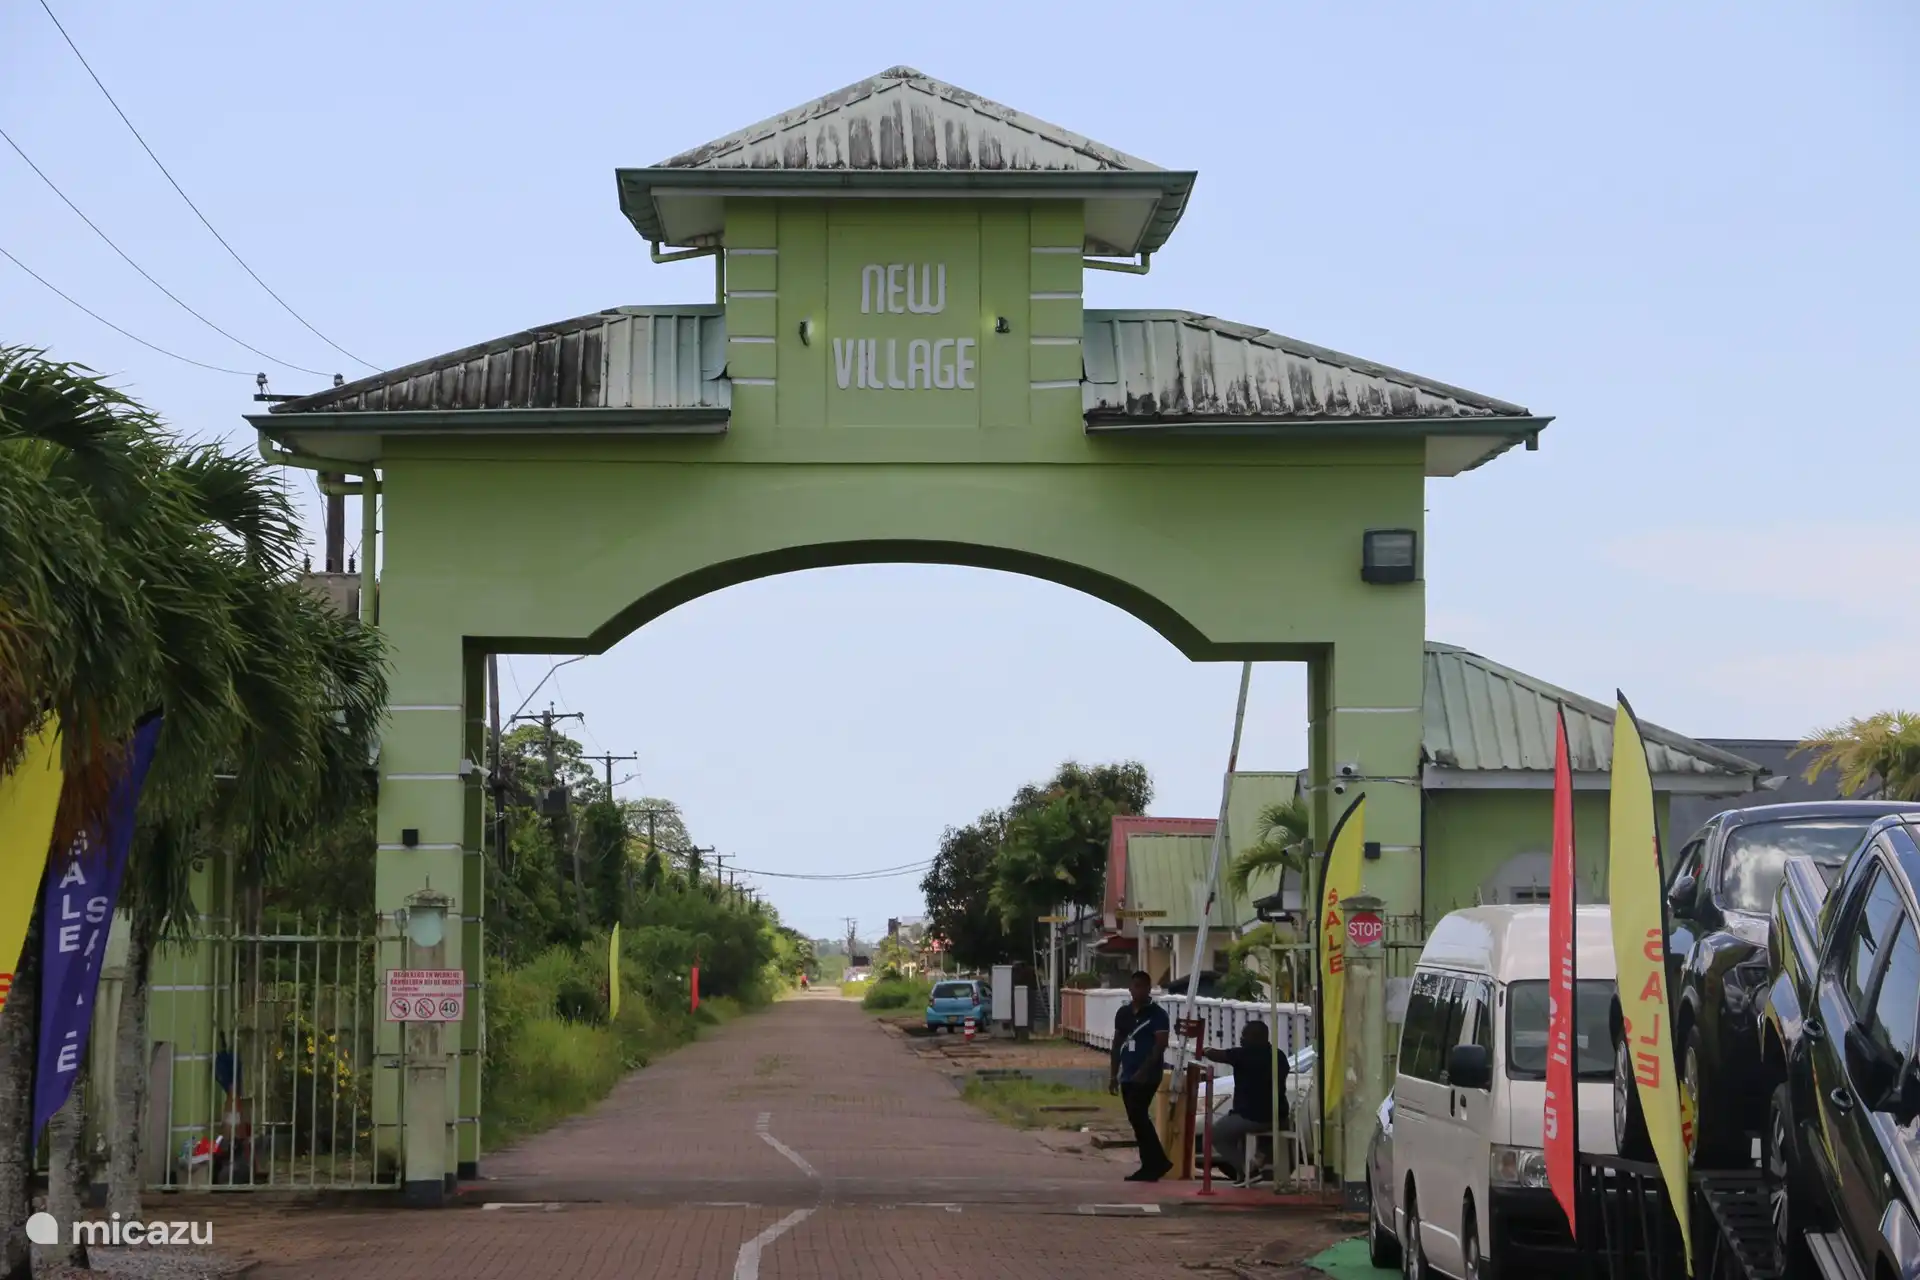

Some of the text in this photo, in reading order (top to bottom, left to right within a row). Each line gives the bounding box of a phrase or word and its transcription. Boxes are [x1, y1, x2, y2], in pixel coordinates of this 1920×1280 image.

[860, 262, 947, 314] NEW
[832, 337, 976, 390] VILLAGE
[1325, 888, 1344, 975] SALE
[1349, 922, 1383, 937] STOP
[443, 1002, 457, 1013] 40
